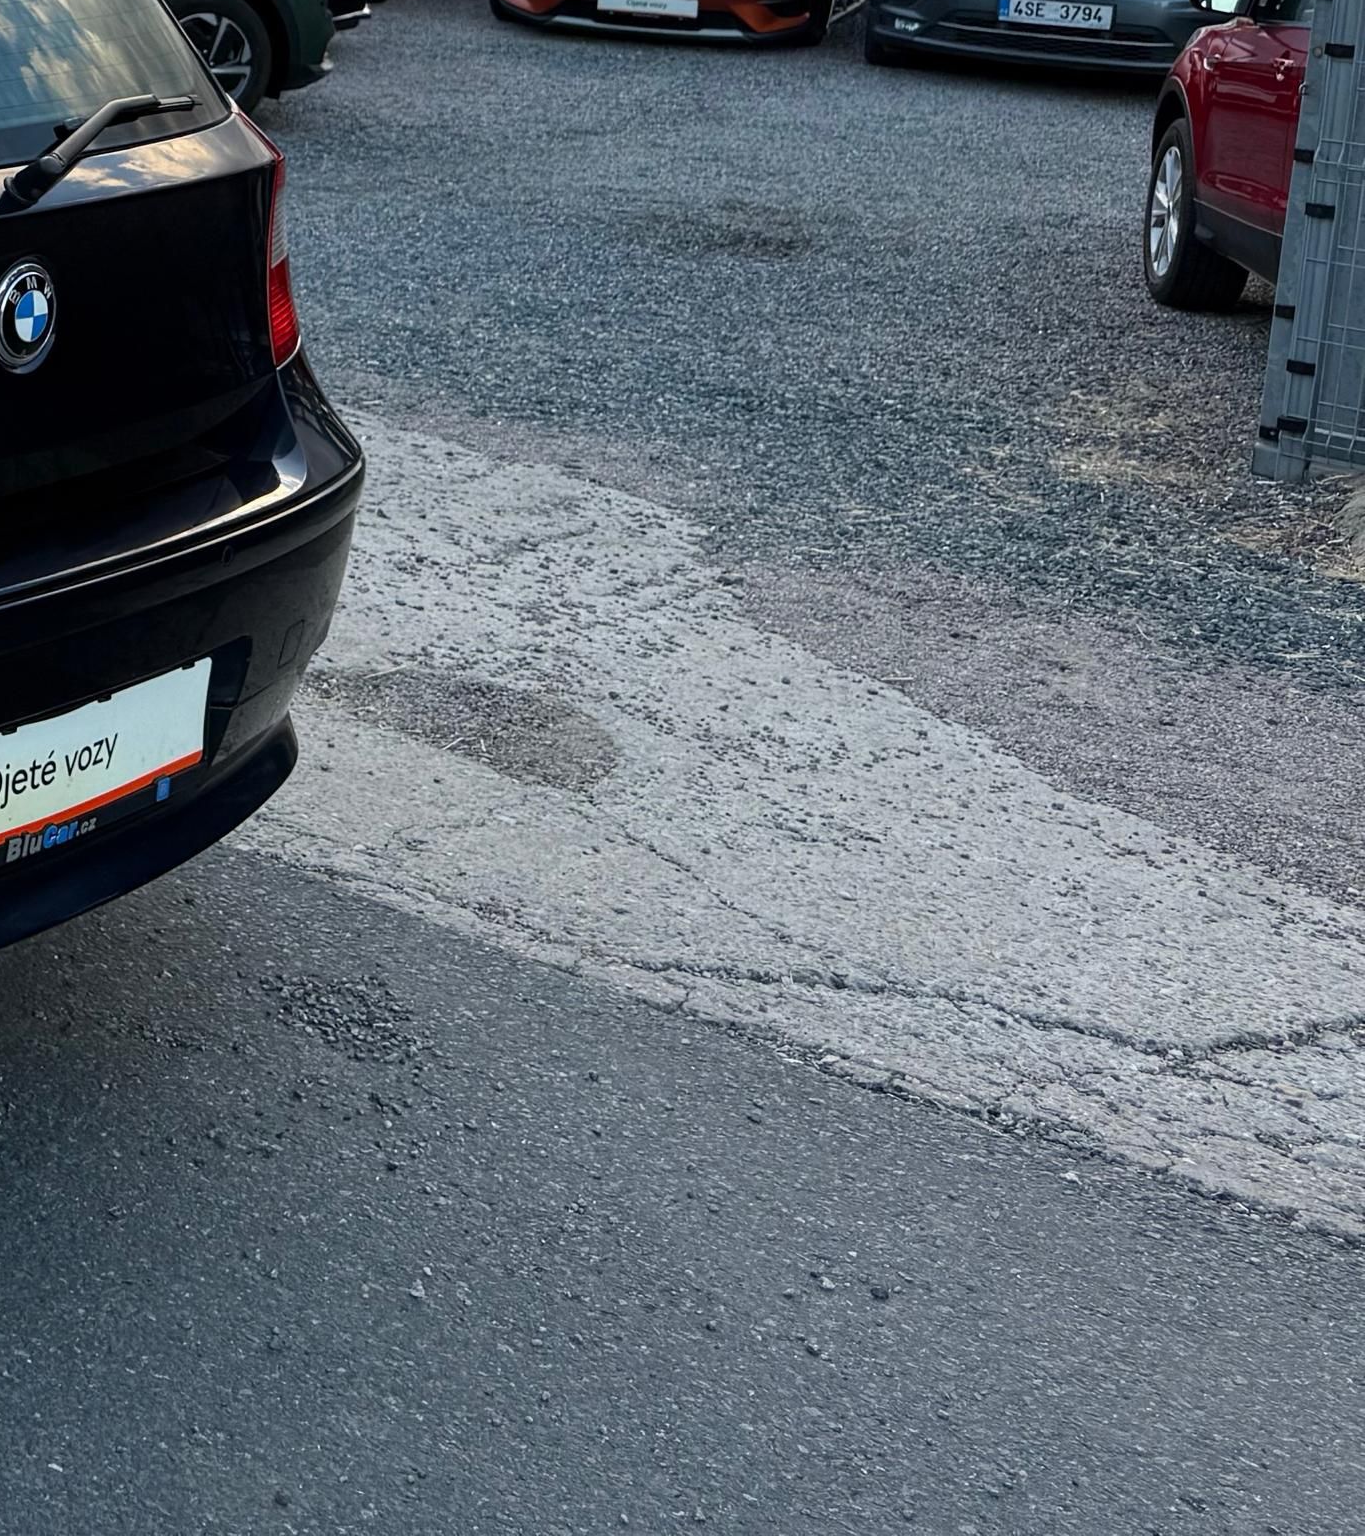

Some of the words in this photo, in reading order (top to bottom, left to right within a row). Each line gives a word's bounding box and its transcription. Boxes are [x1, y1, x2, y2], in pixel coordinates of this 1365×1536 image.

[1013, 0, 1046, 18] 4SE
[1060, 4, 1103, 23] 3794
[9, 276, 52, 305] BMW
[65, 732, 118, 777] vozy
[6, 817, 97, 863] BluCar.cz
